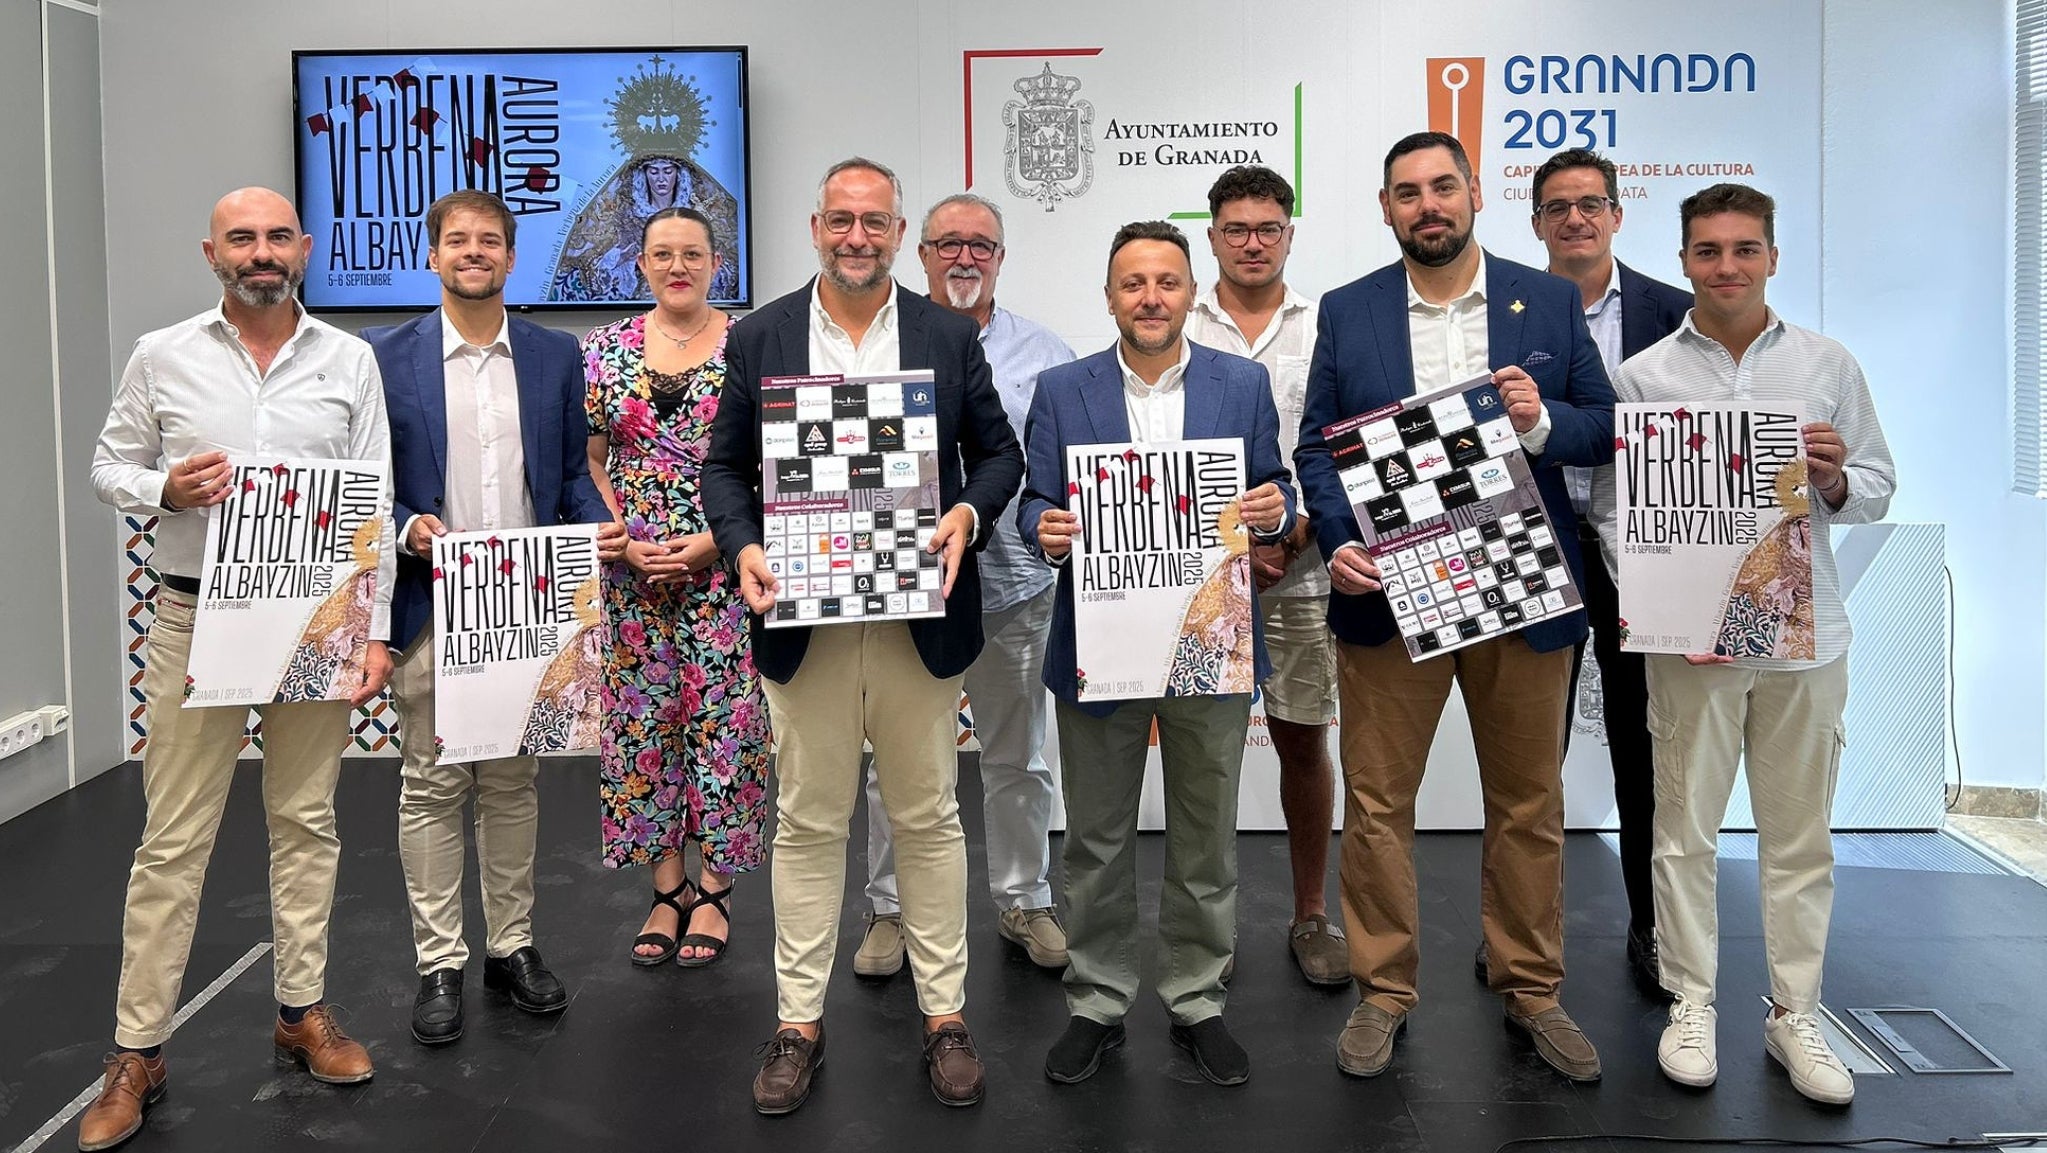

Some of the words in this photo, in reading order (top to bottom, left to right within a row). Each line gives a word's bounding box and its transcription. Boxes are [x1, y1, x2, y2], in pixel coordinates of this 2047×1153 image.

[1503, 53, 1755, 94] GRANADA
[325, 75, 503, 218] VERBENA
[503, 76, 561, 215] AURORA
[1503, 109, 1616, 150] 2031
[1504, 165, 1536, 178] CAPI
[1642, 164, 1661, 176] DE
[1665, 164, 1684, 176] LA
[1686, 163, 1754, 176] CULTURA
[330, 221, 430, 271] ALBAY
[328, 273, 344, 287] 5-6
[345, 272, 393, 287] SEPTIEMBRE
[1624, 411, 1756, 509] VERBENA
[216, 466, 341, 564] VERBENA
[1076, 451, 1201, 555] VERBENA
[1626, 510, 1734, 546] ALBAYZIN
[1735, 511, 1758, 545] 2025
[1637, 545, 1673, 555] SEPTIEMBRE
[207, 566, 313, 600] ALBAYZIN
[312, 566, 333, 597] 2025
[441, 536, 558, 633] VERBENA
[1082, 551, 1182, 592] ALBAYZIN
[1182, 552, 1204, 586] 2025
[217, 601, 252, 610] SEPTIEMBRE
[1093, 592, 1126, 602] SEPTIEMBRE
[443, 628, 539, 667] ALBAYZIN
[539, 625, 559, 657] 2025
[453, 665, 485, 676] SEPTIEMBRE
